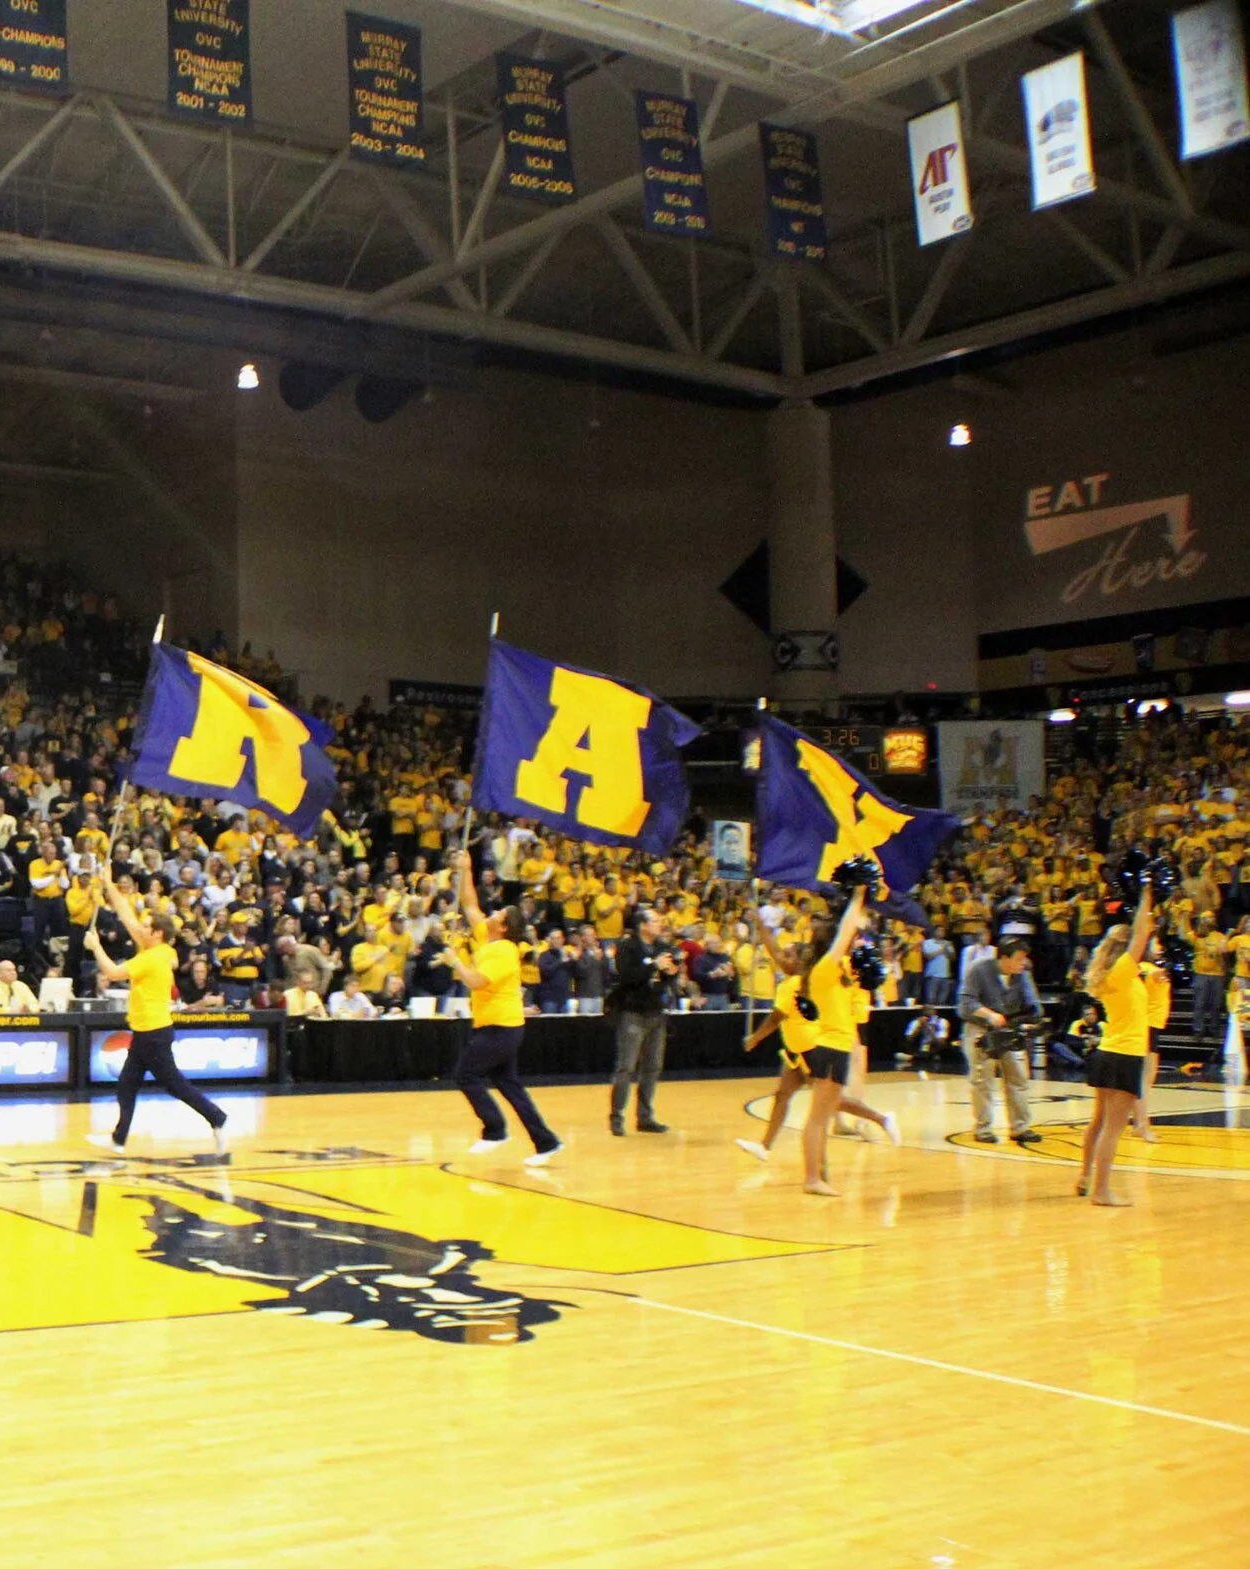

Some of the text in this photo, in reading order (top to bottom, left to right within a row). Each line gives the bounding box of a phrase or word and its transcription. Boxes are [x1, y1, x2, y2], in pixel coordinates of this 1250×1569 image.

[10, 0, 39, 13] OVC
[195, 32, 222, 49] OVC
[360, 31, 407, 53] MURRAY
[30, 64, 61, 80] 2000
[194, 77, 230, 96] NCAA
[374, 76, 398, 91] OVC
[176, 91, 204, 109] 2001
[217, 100, 246, 117] 2002
[354, 88, 418, 113] TOURNAMENT
[372, 120, 405, 138] NCAA
[350, 132, 383, 152] 2003
[1026, 471, 1110, 518] EAT
[514, 666, 652, 837] A
